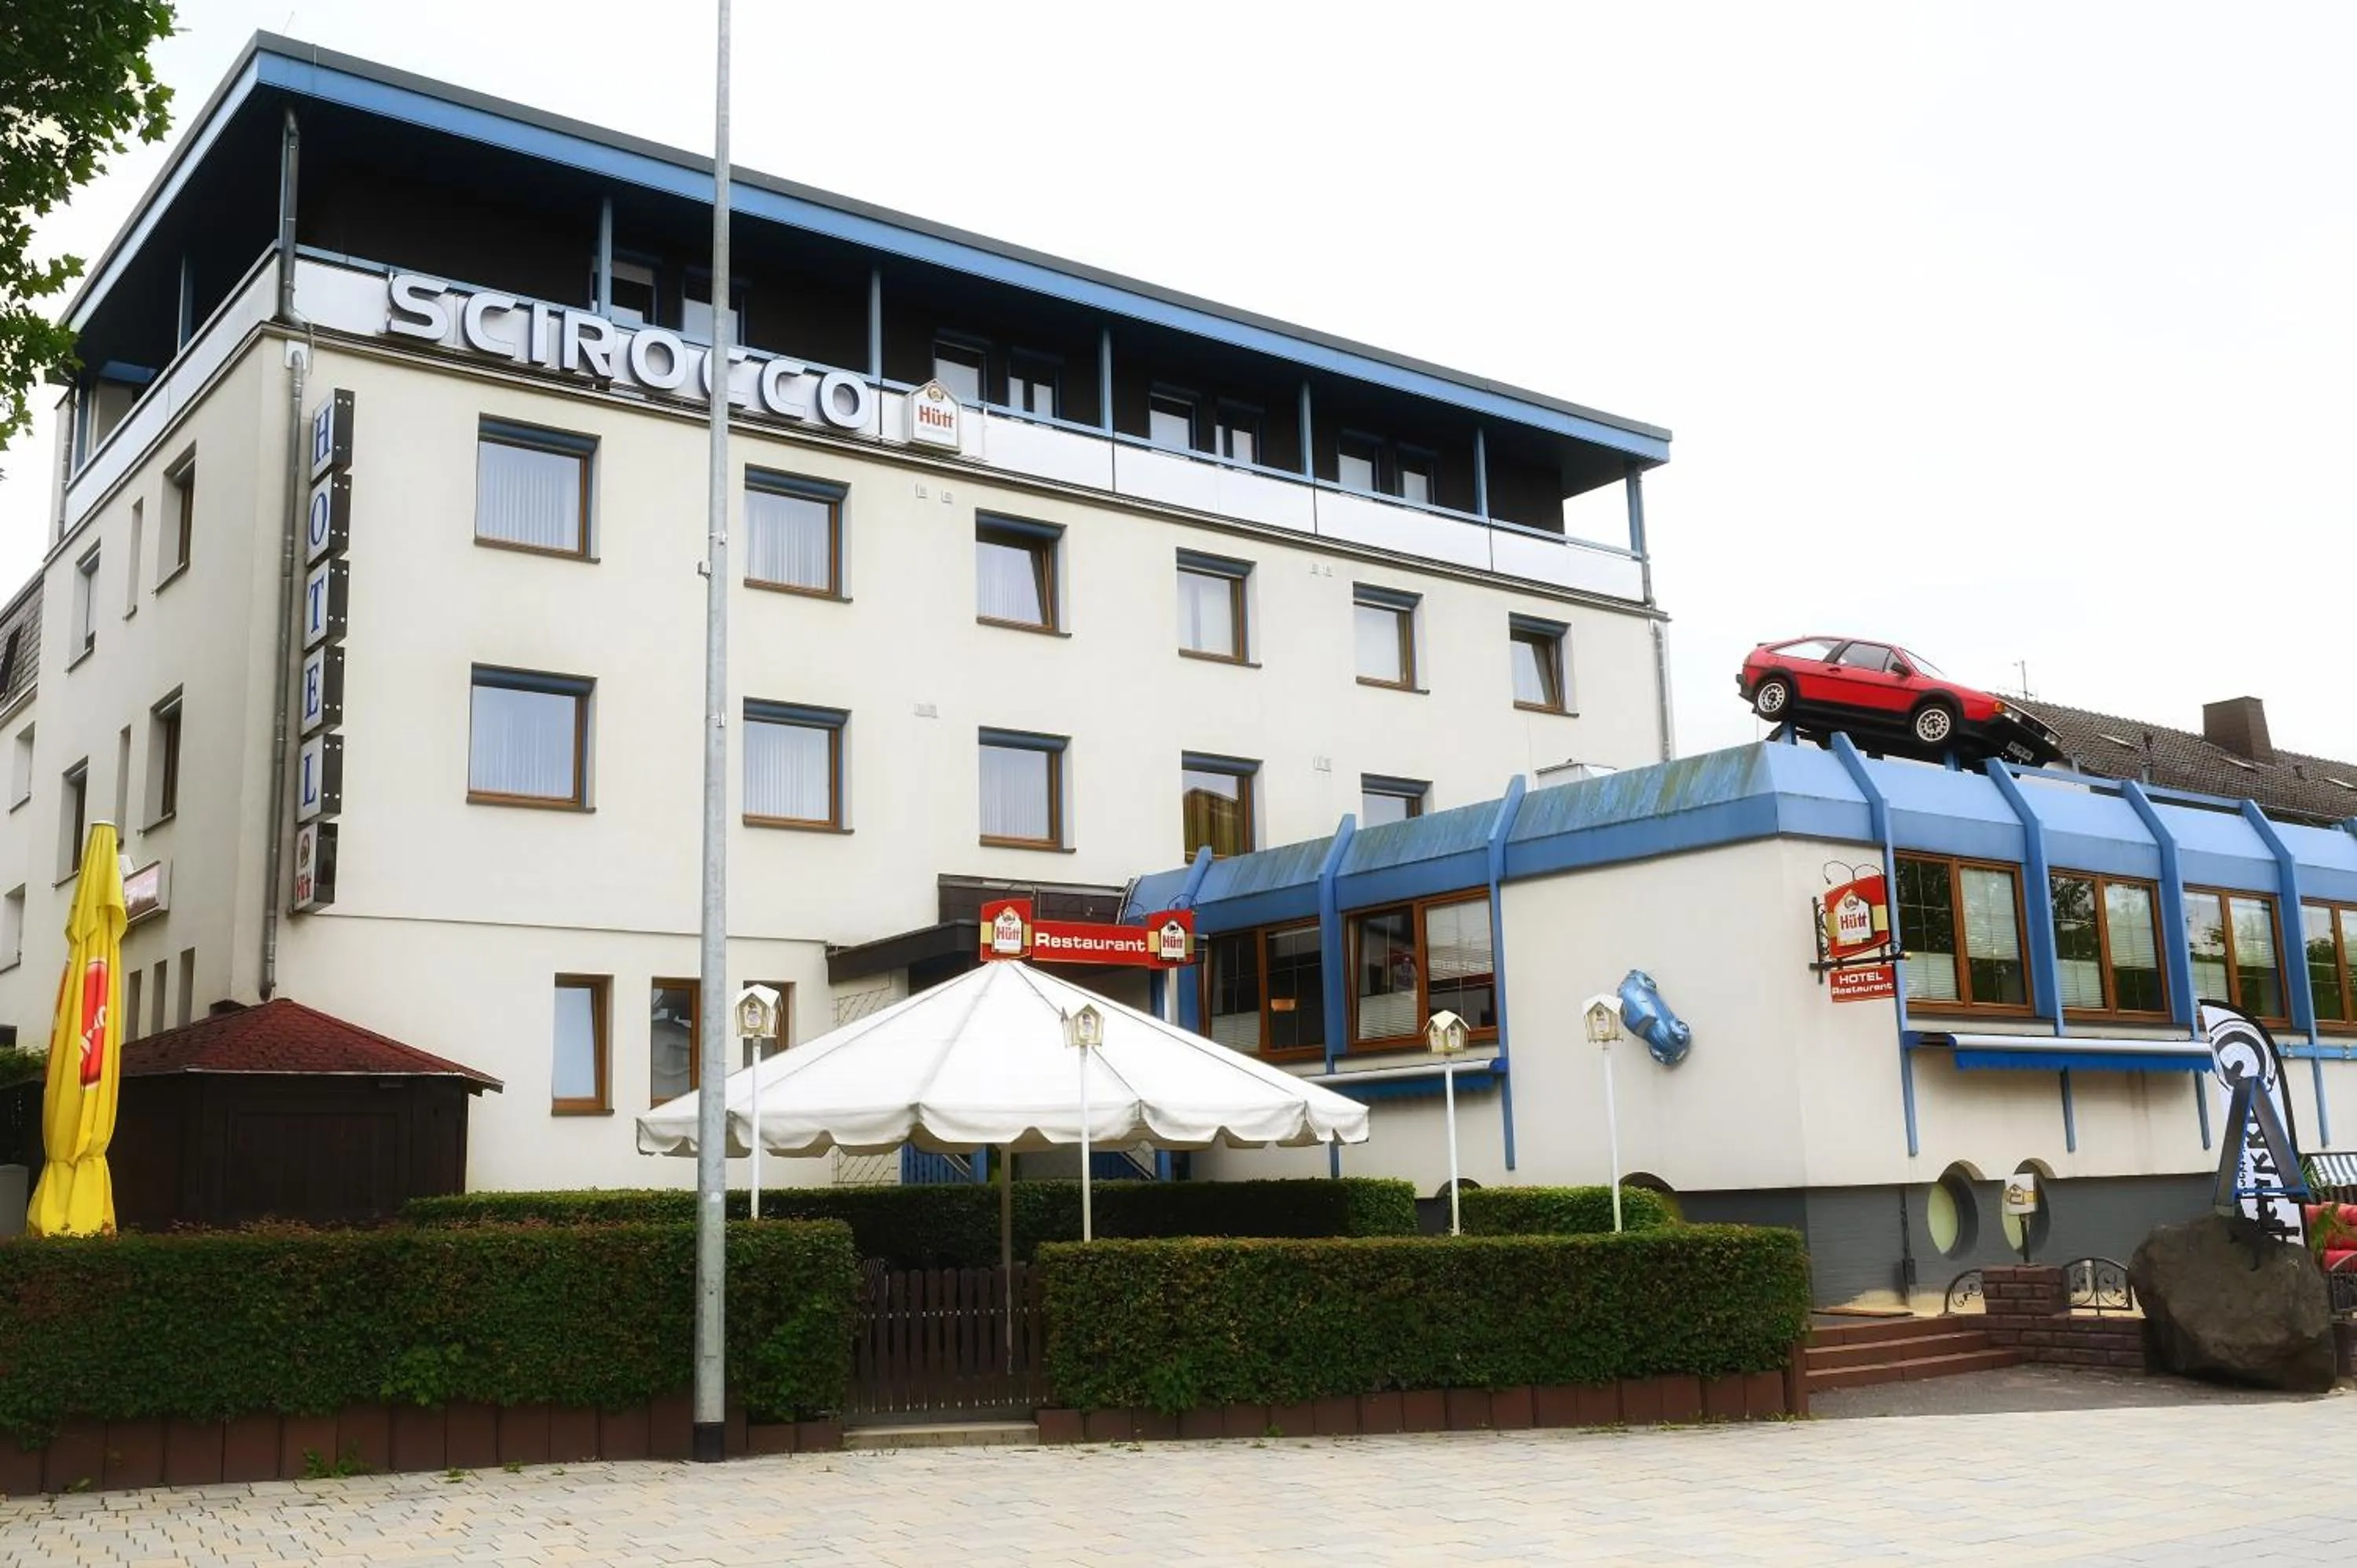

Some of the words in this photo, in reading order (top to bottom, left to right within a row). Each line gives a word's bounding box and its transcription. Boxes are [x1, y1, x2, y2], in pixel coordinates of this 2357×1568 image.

[387, 273, 872, 430] SCIROCCO
[918, 405, 955, 428] Hütt
[302, 403, 332, 807] HOTEL
[1839, 914, 1868, 930] Hütt
[995, 925, 1021, 941] Hütt
[1035, 932, 1146, 953] Restaurant
[1162, 934, 1183, 949] Hütt
[1838, 972, 1883, 984] HOTEL
